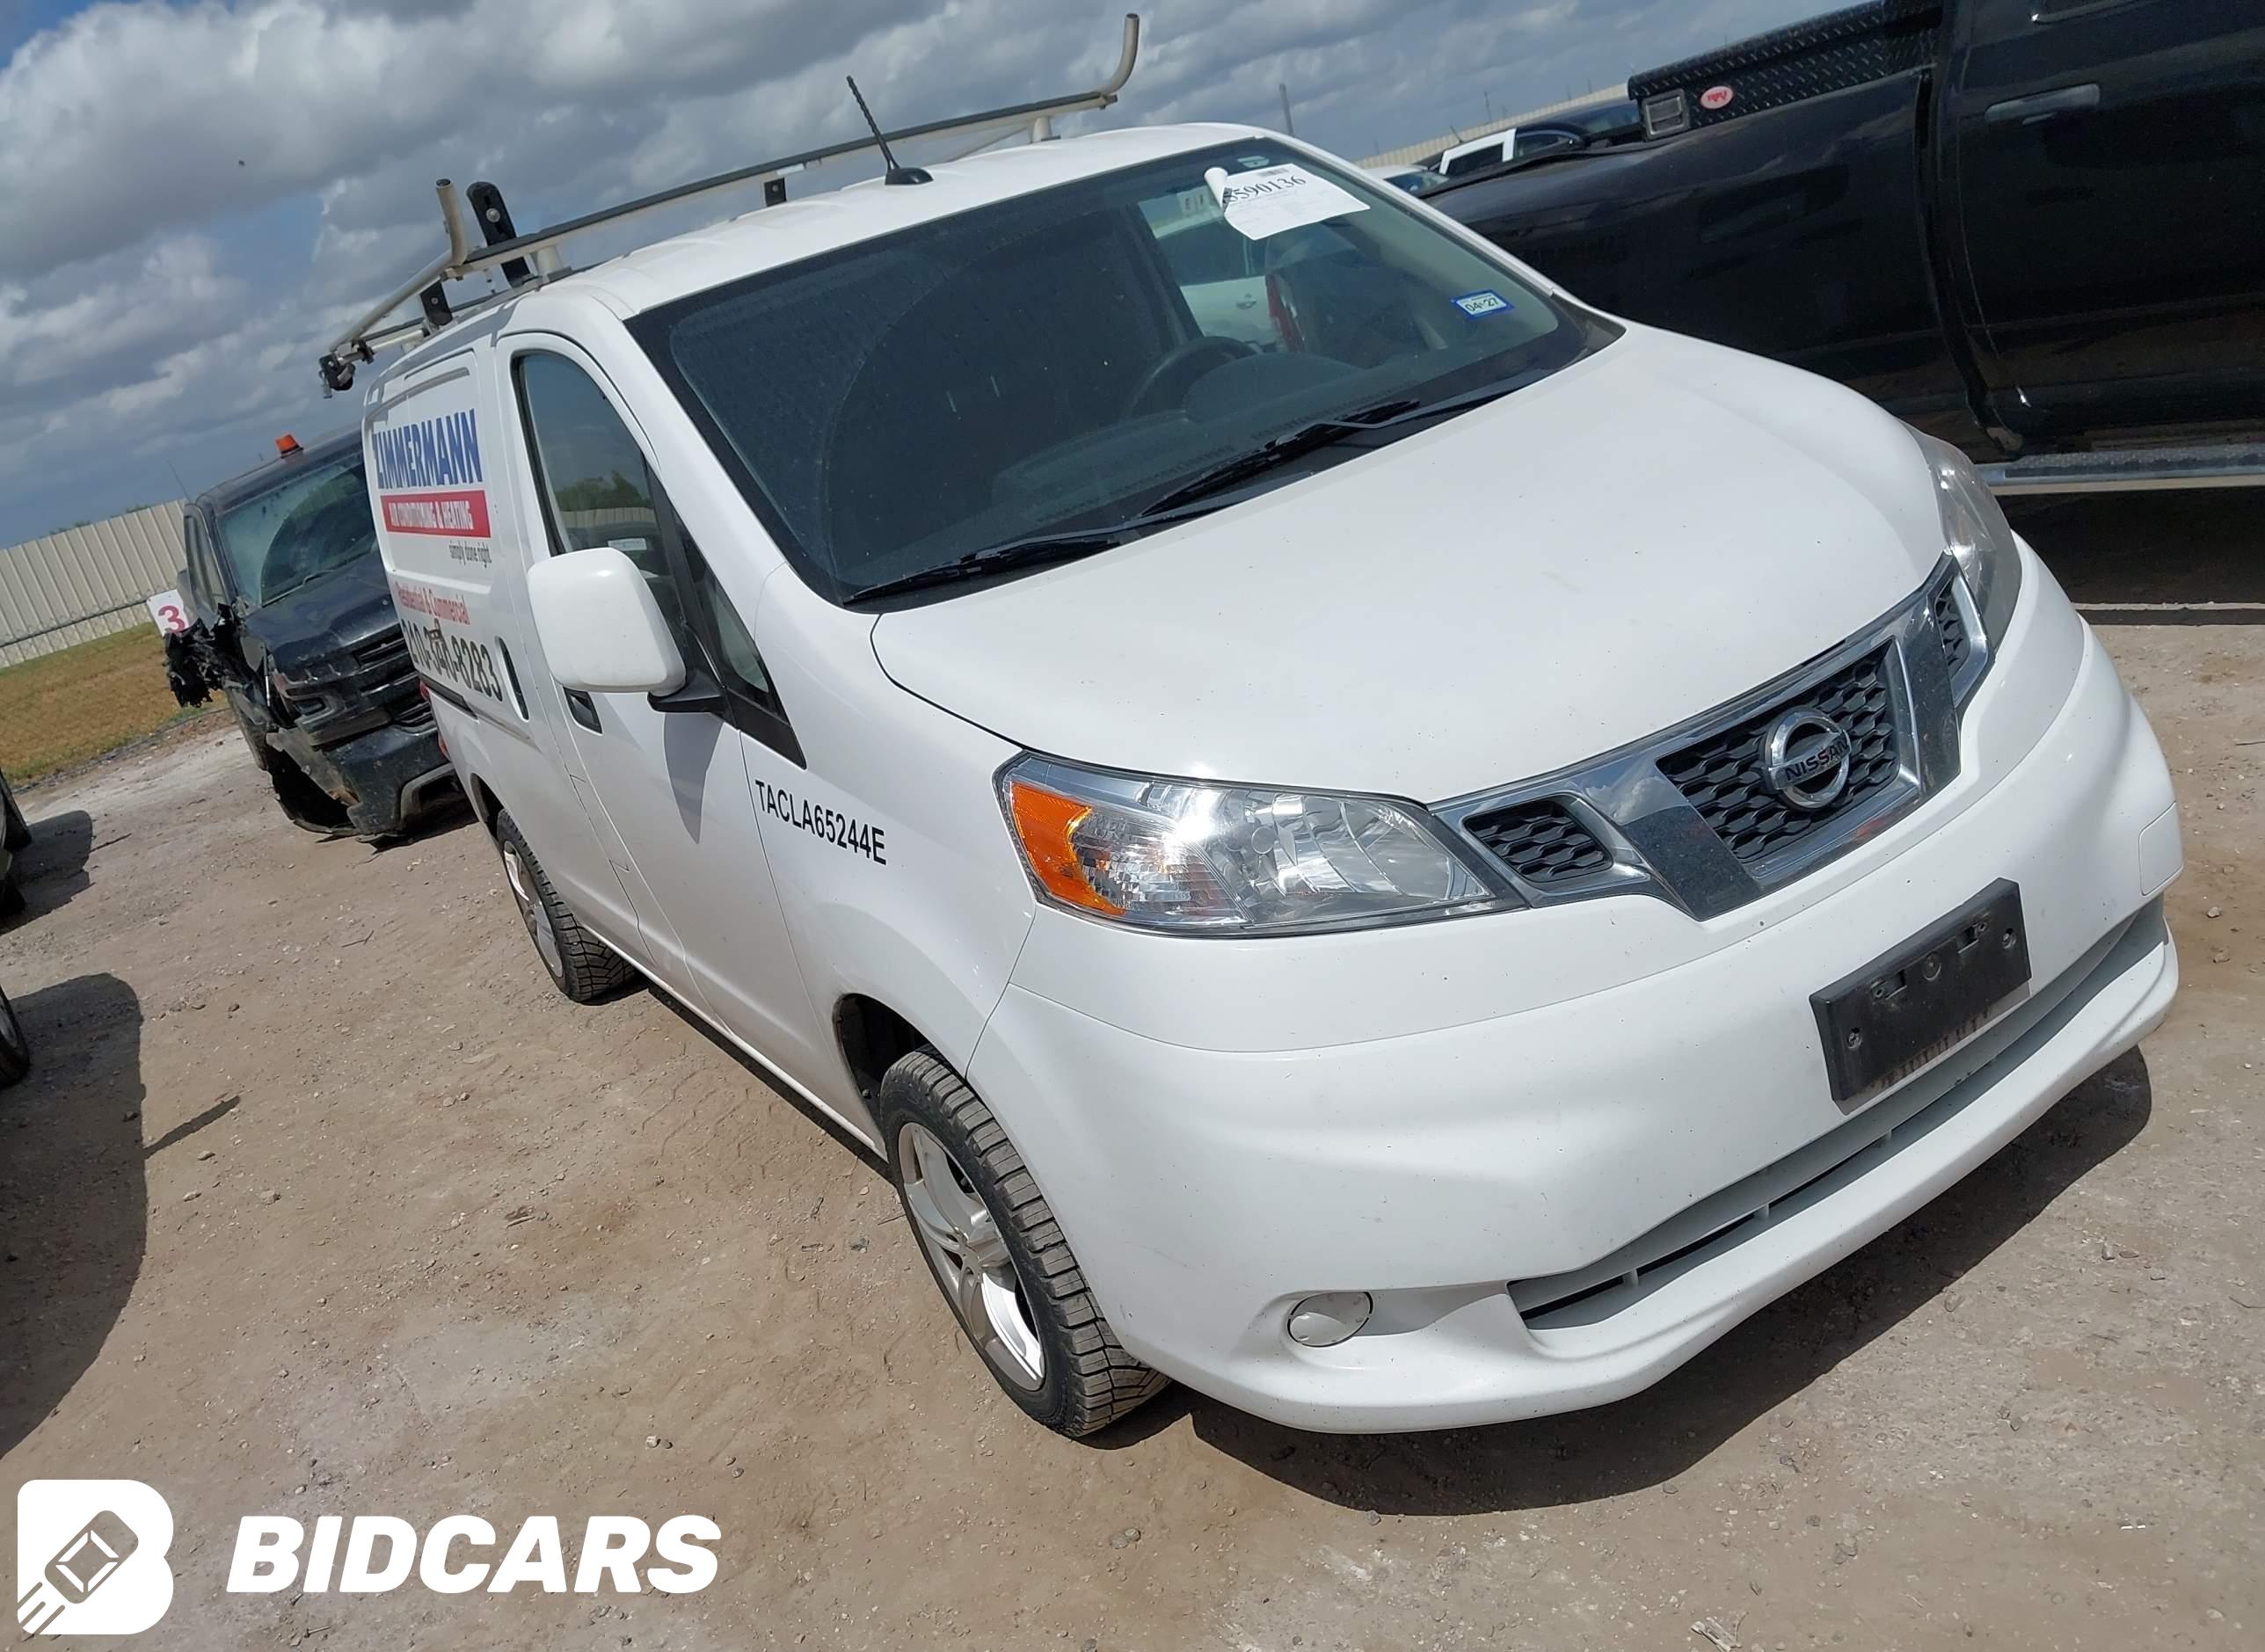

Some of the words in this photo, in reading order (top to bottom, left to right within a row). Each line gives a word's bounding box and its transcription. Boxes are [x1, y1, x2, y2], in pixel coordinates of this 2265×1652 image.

[372, 408, 483, 490] ZIMMERMANN
[441, 500, 474, 530] HEATING
[157, 605, 186, 634] 3
[428, 588, 471, 625] Commercial
[1785, 736, 1849, 782] NISSAN
[754, 779, 887, 866] TACLA65244E
